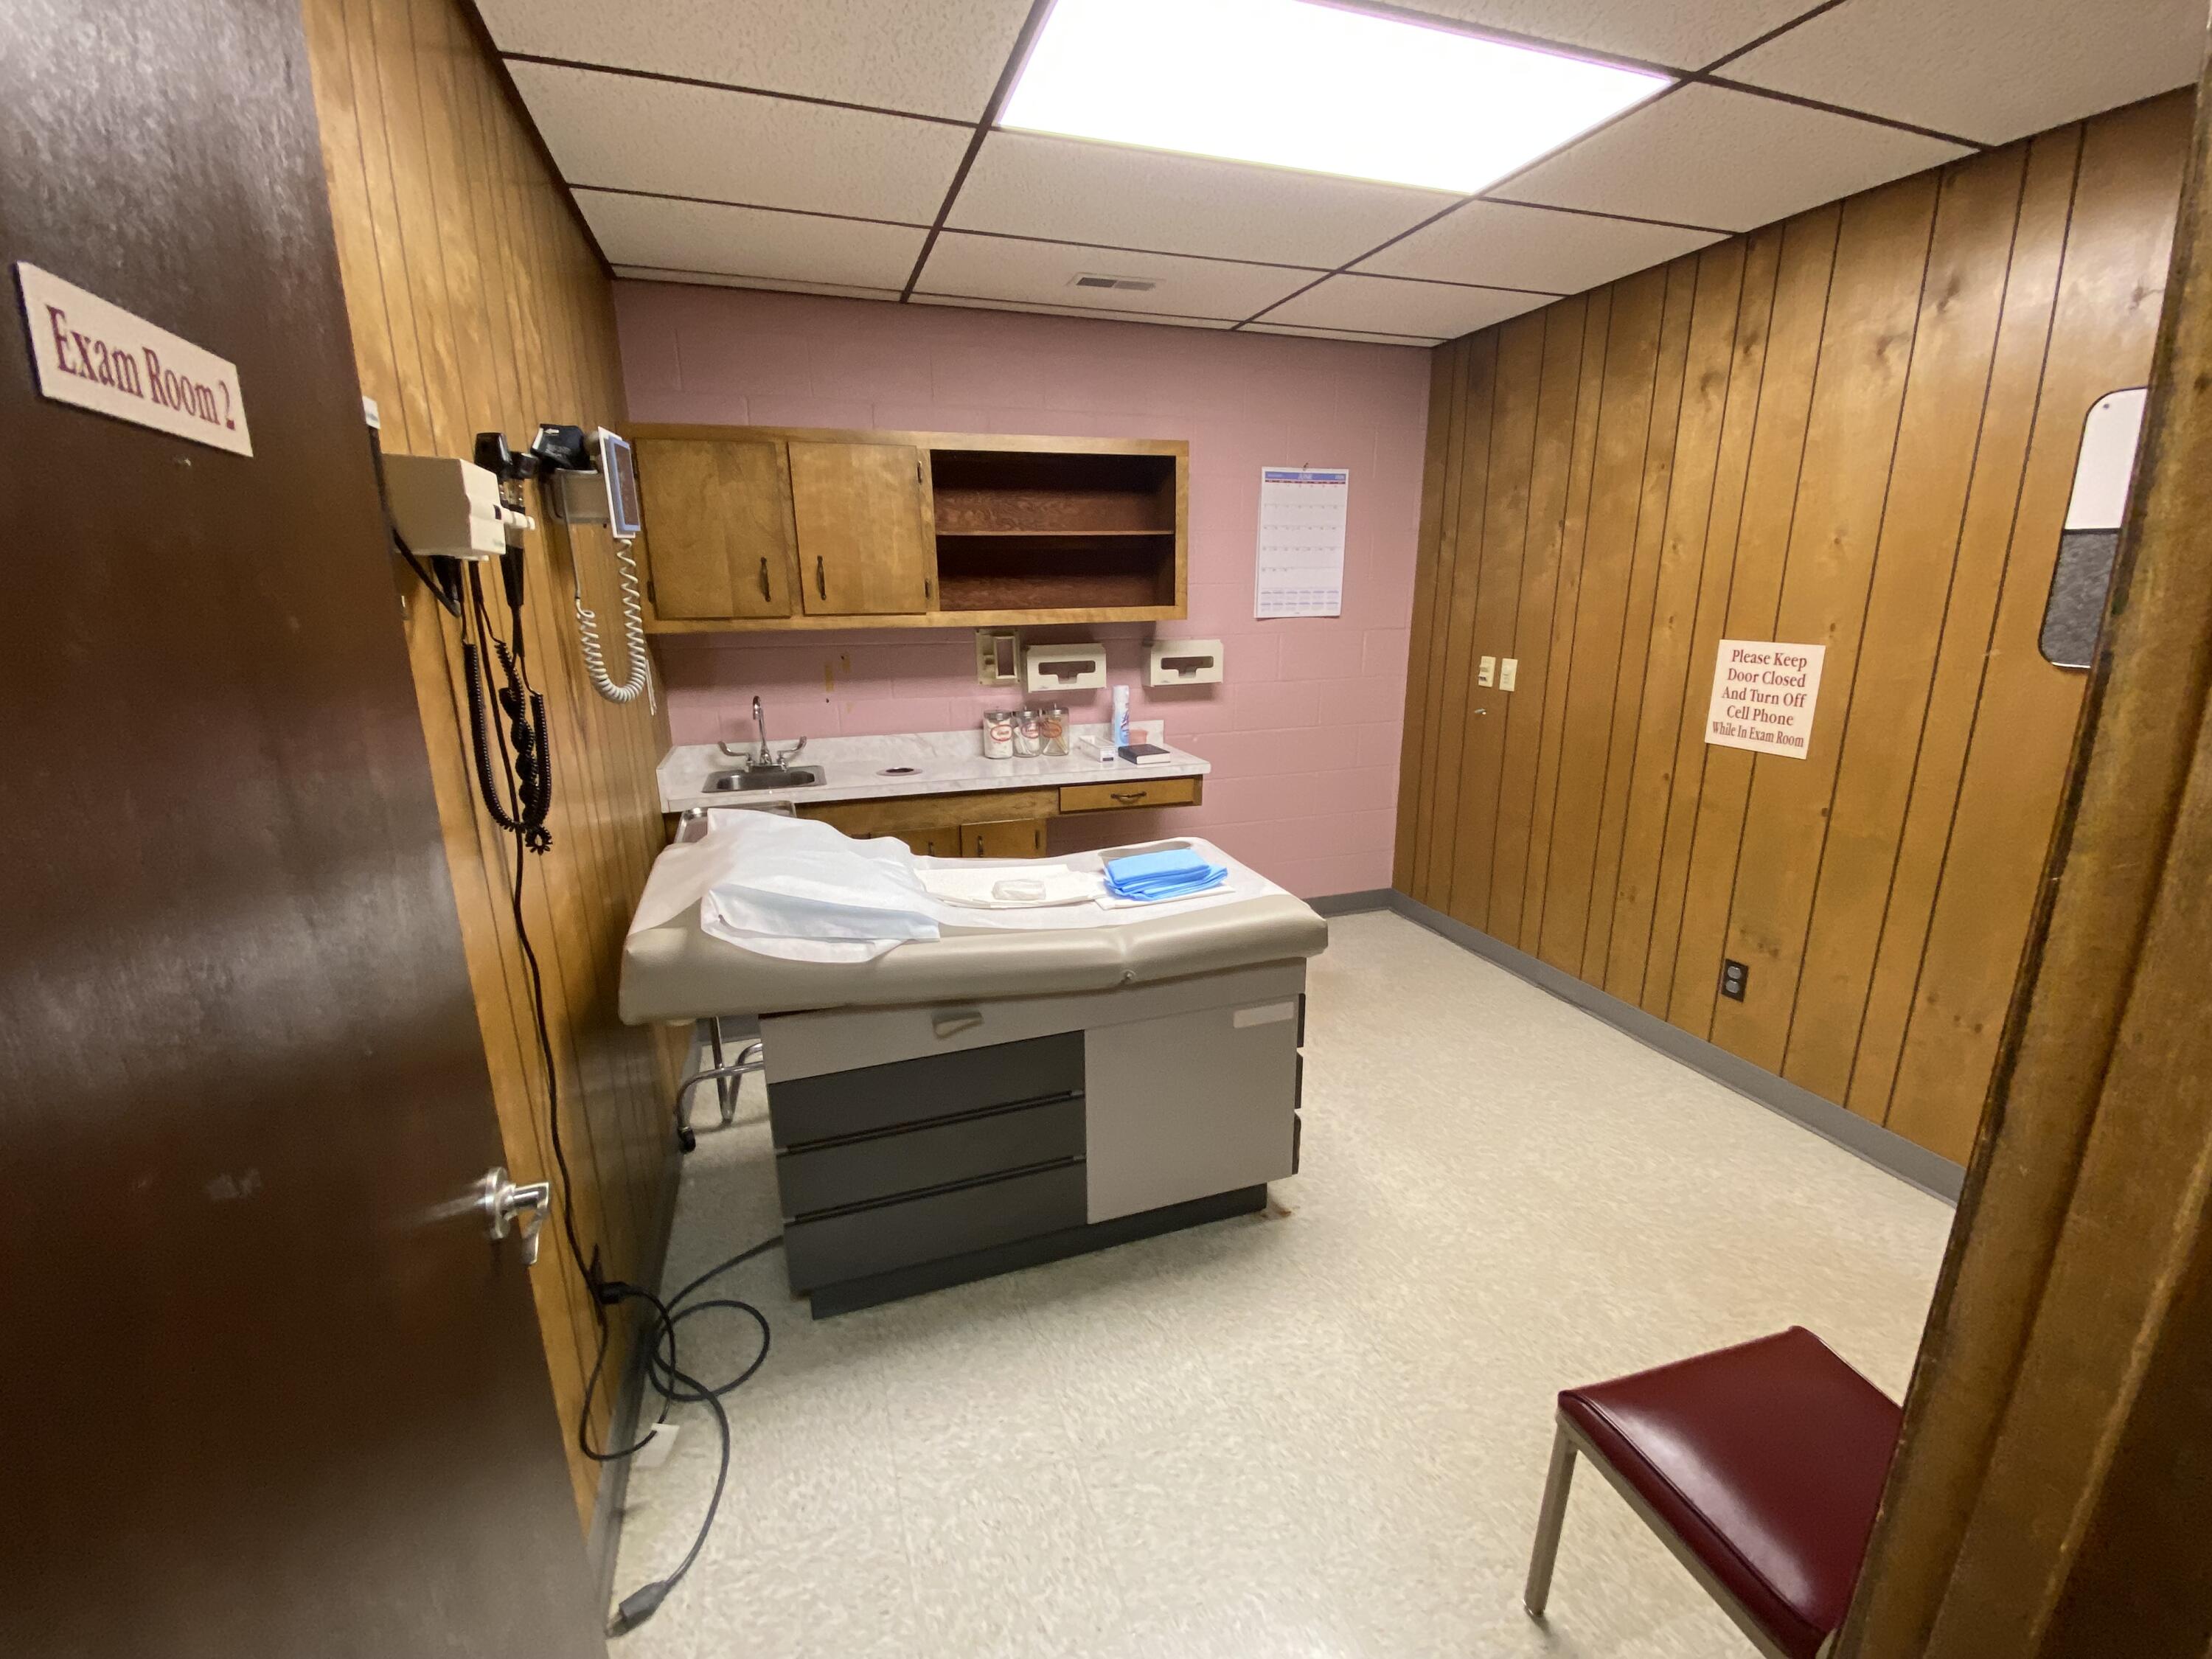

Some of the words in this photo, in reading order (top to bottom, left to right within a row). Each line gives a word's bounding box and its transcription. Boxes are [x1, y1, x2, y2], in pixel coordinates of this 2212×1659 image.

[46, 305, 144, 398] Exam
[142, 347, 220, 425] Room
[1731, 649, 1770, 665] Please
[1773, 653, 1807, 672] Keep
[1727, 668, 1759, 683] Door
[1761, 671, 1806, 687] Closed
[1722, 686, 1747, 700] And
[1750, 689, 1779, 705] Turn
[1783, 693, 1806, 708] Off
[1727, 705, 1750, 720] Cell
[1753, 708, 1794, 726] Phone
[1712, 721, 1736, 737] While
[1737, 725, 1747, 738] In
[1749, 726, 1775, 743] Exam
[1775, 731, 1804, 748] Room
